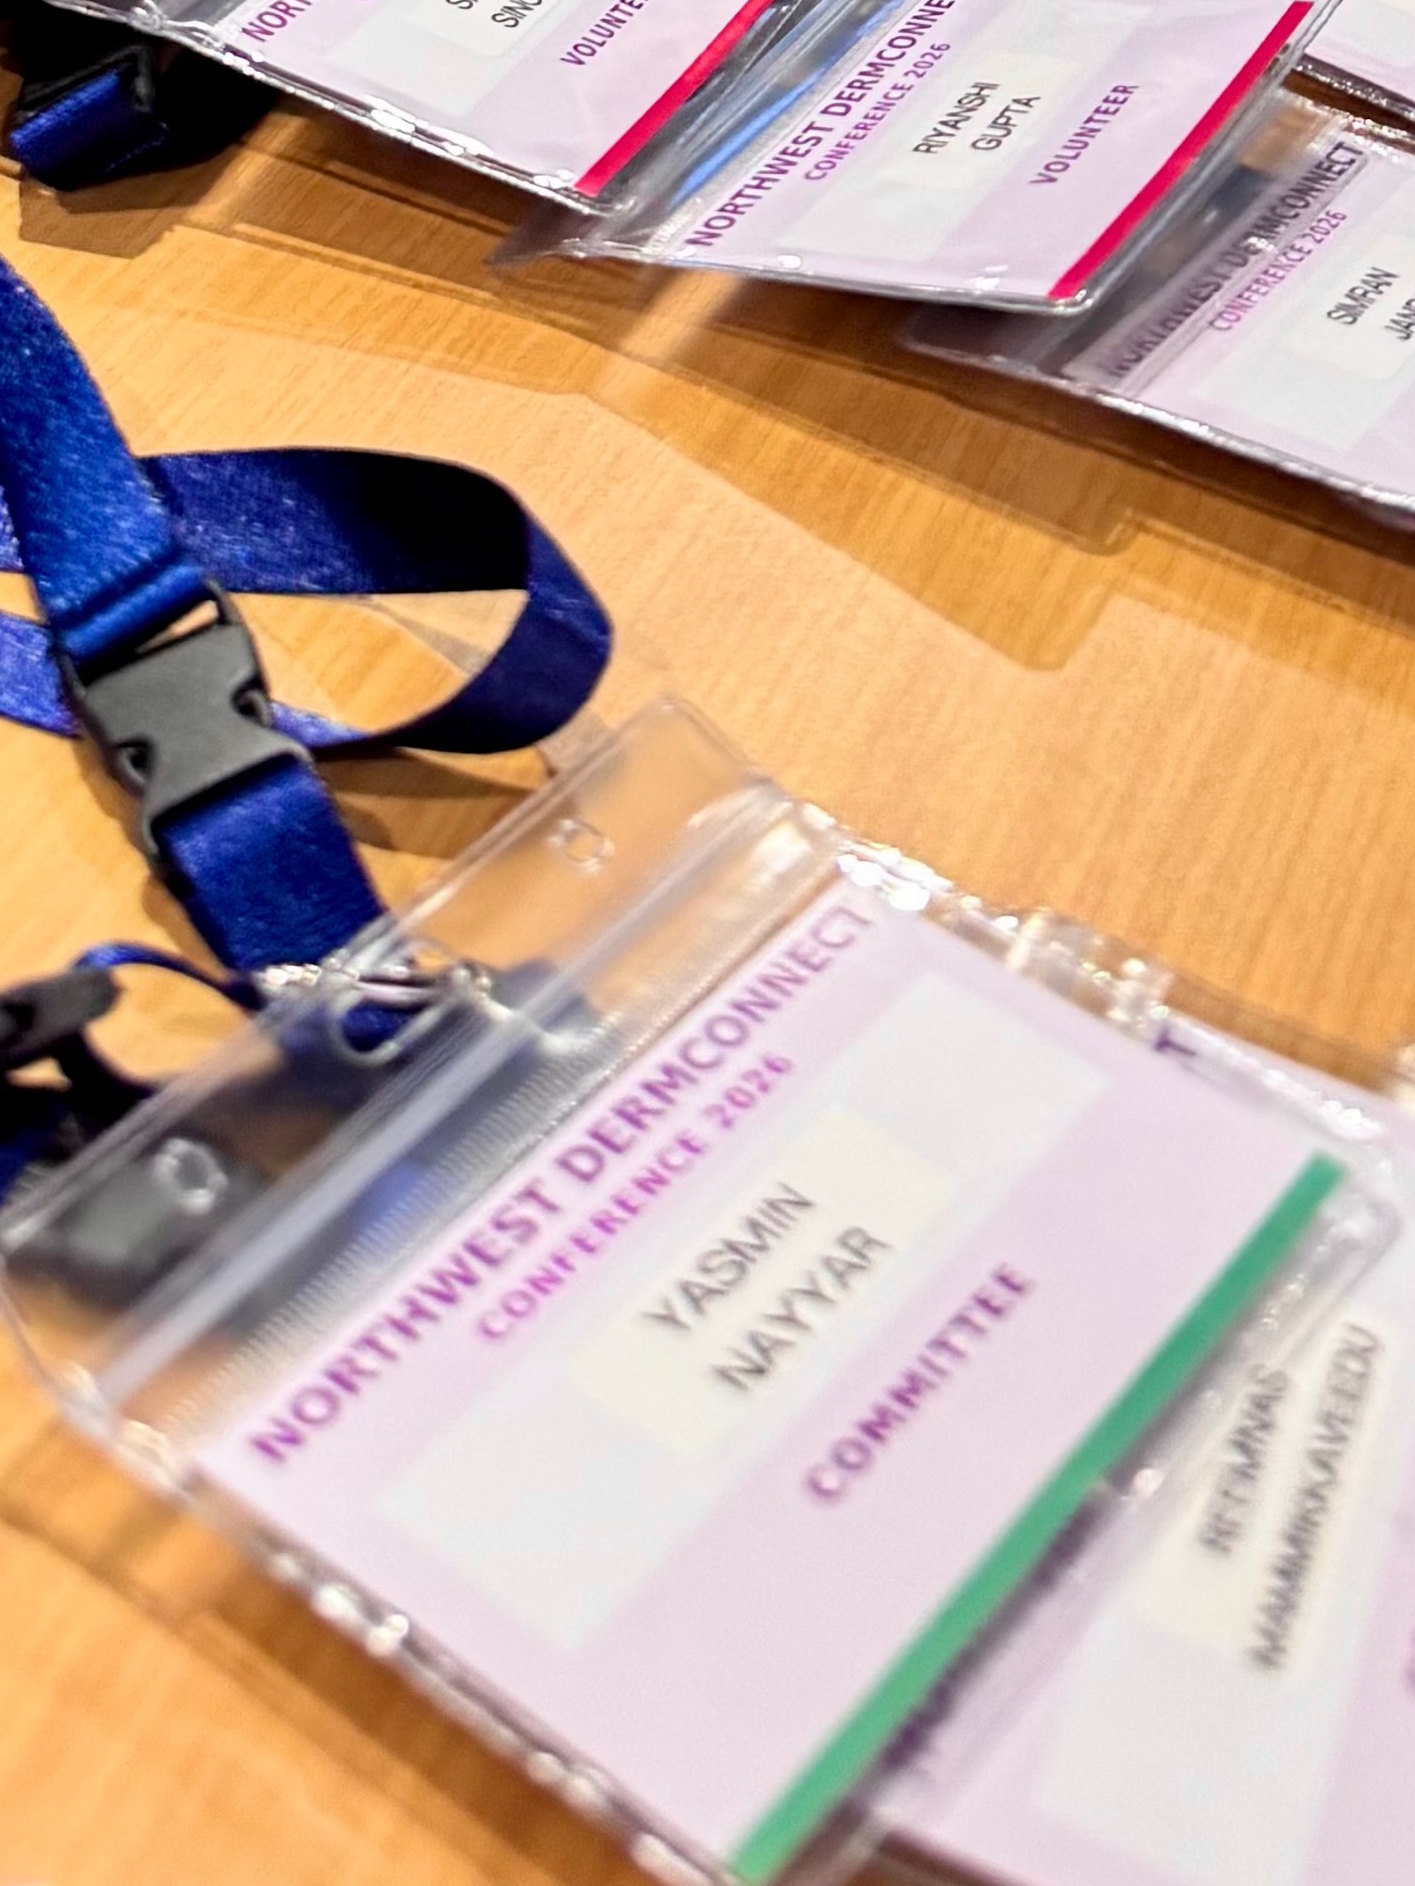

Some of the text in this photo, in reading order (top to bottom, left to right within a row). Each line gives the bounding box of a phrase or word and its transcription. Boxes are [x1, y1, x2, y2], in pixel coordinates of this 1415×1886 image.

[802, 41, 952, 181] CONFERENCE 2026
[911, 82, 999, 155] RIYANSHI
[973, 93, 1041, 153] GUPTA
[1031, 83, 1140, 186] VOLUNTEER
[686, 120, 834, 248] NORTHWEST
[1209, 208, 1348, 332] CONFERENCE 2026
[1325, 265, 1402, 327] SIMRAN
[250, 905, 873, 1465] NORTHWEST DERMCONNECT
[476, 1052, 797, 1345] CONFERENCE 2026
[640, 1181, 818, 1339] YASMIN
[710, 1225, 892, 1394] NAYYAR
[804, 1263, 1035, 1509] COMMITTEE
